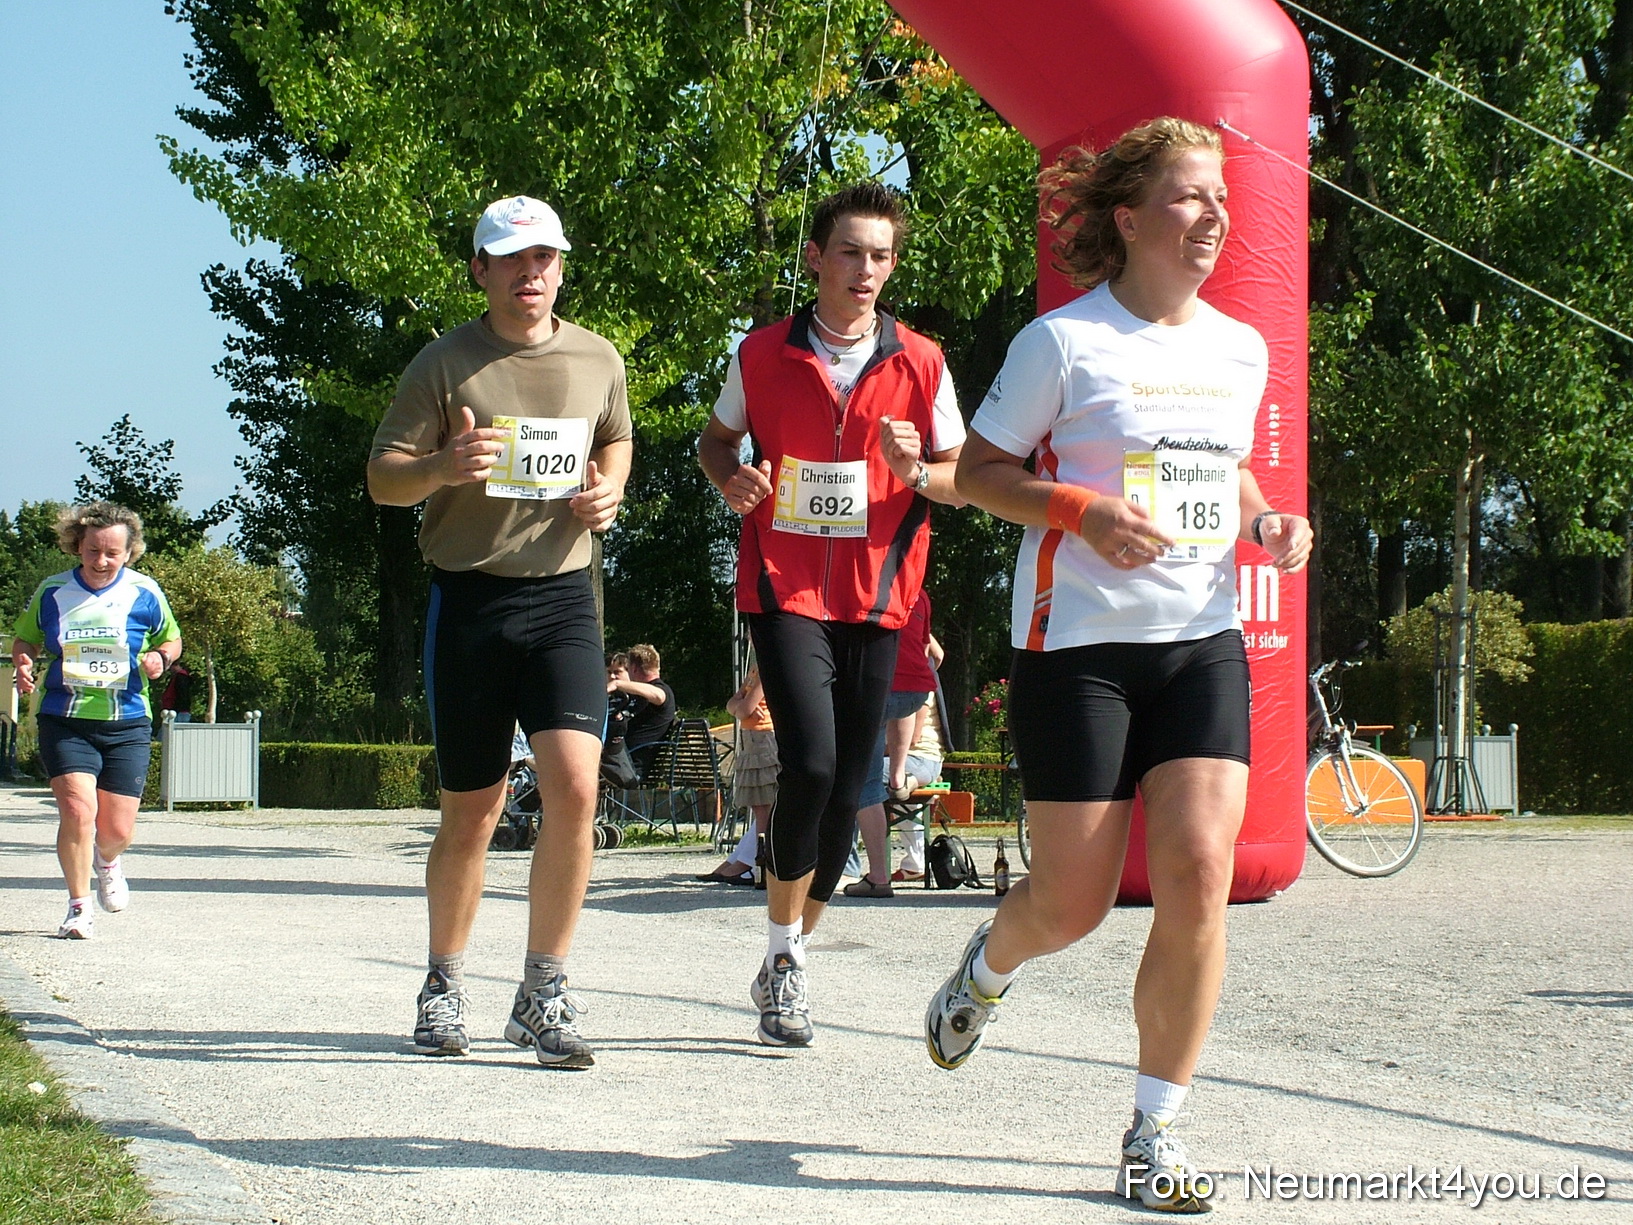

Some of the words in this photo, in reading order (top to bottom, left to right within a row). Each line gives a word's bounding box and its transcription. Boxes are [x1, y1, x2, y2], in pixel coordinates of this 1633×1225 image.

[1268, 403, 1281, 436] 1929
[520, 424, 558, 441] Simon
[1152, 435, 1229, 453] Abendzeitung
[1268, 441, 1280, 467] Seit
[521, 453, 577, 476] 1020
[1161, 461, 1227, 487] Stephanie
[801, 467, 856, 484] Christian
[809, 495, 854, 518] 692
[1176, 501, 1221, 531] 185
[66, 626, 120, 640] BOCK
[1258, 628, 1288, 649] sicher
[81, 646, 113, 655] Christa
[89, 660, 119, 675] 653
